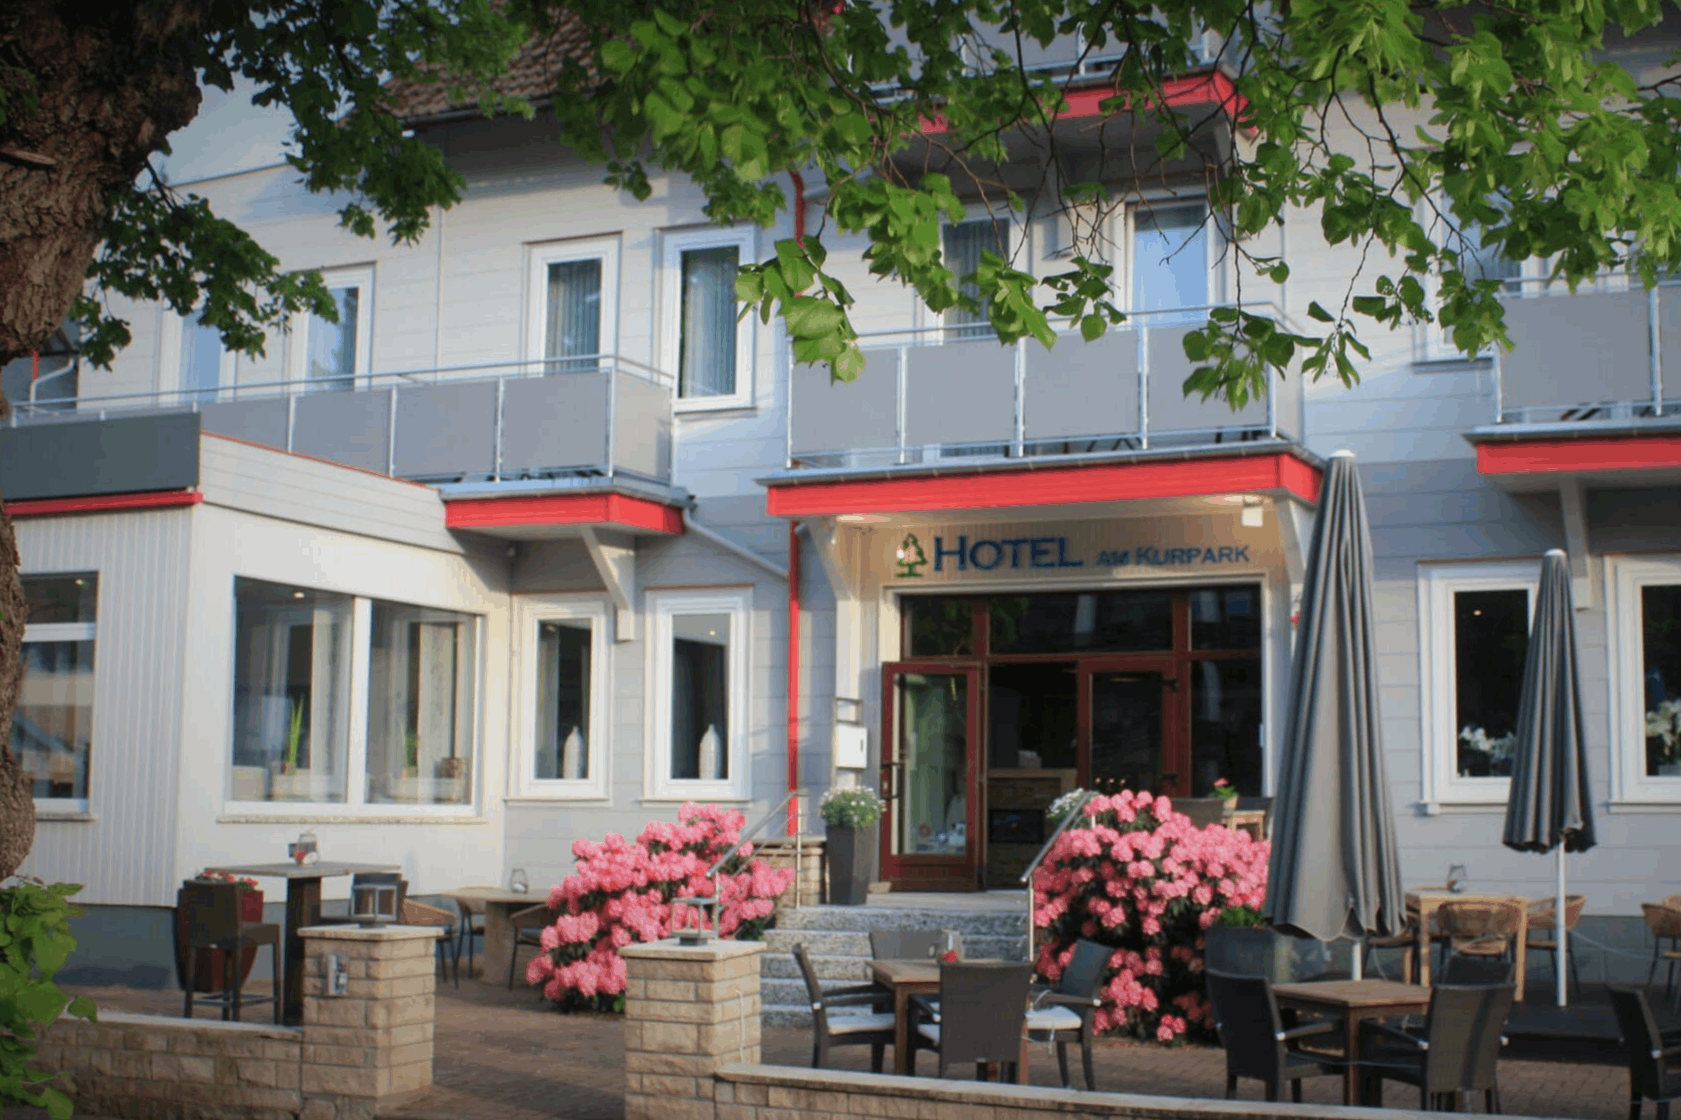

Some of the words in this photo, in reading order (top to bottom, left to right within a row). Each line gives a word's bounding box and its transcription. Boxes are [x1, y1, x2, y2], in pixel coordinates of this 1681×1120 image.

[933, 535, 1084, 571] HOTEL
[1096, 550, 1130, 567] AM
[1136, 545, 1250, 567] KURPARK
